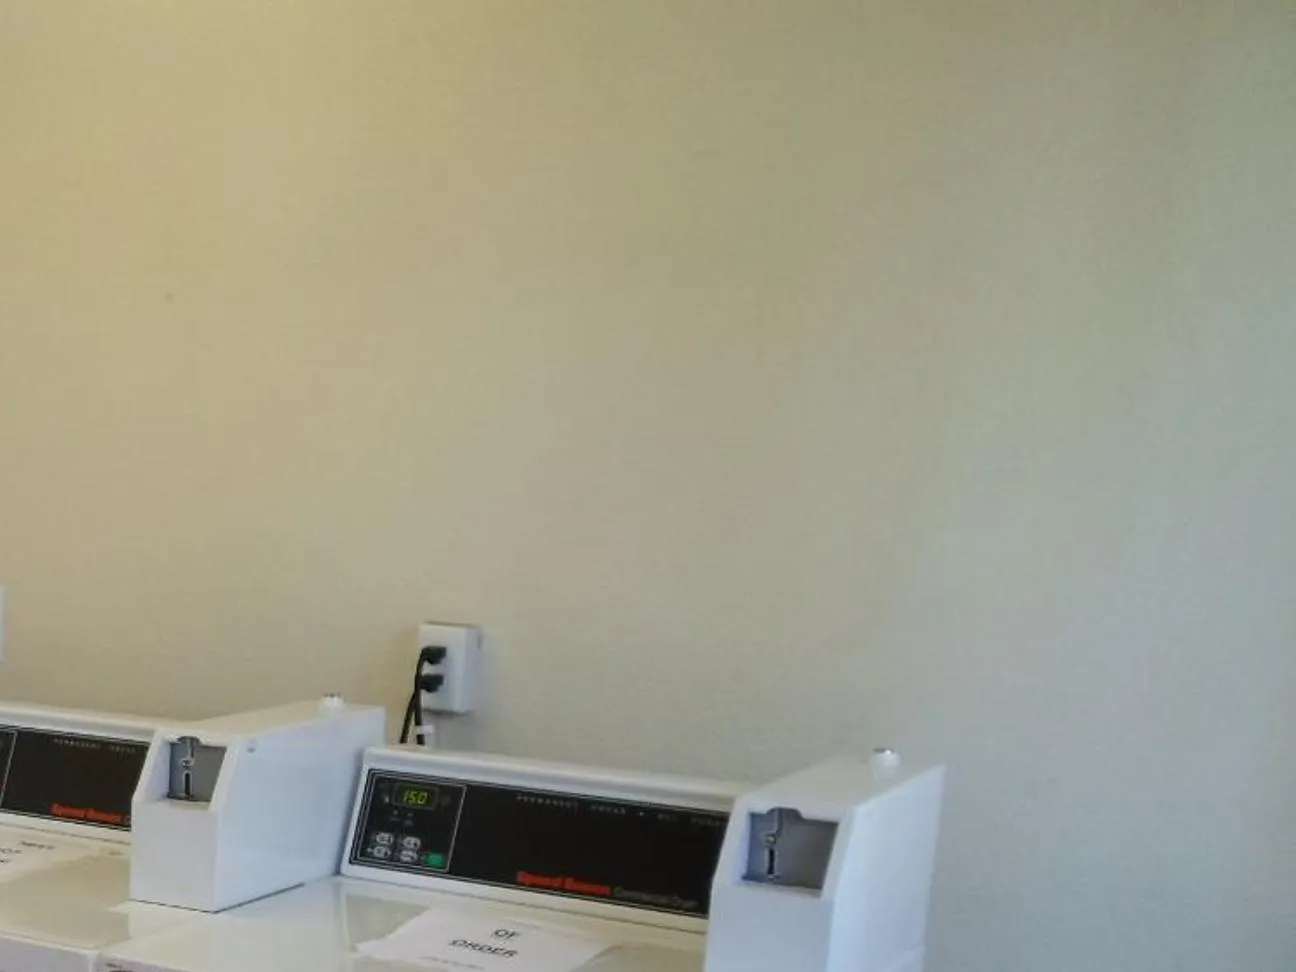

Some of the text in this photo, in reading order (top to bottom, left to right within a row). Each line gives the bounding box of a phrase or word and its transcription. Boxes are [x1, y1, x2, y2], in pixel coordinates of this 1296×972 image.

[402, 789, 429, 805] 150
[492, 928, 521, 940] OF
[449, 939, 518, 958] ORDER
